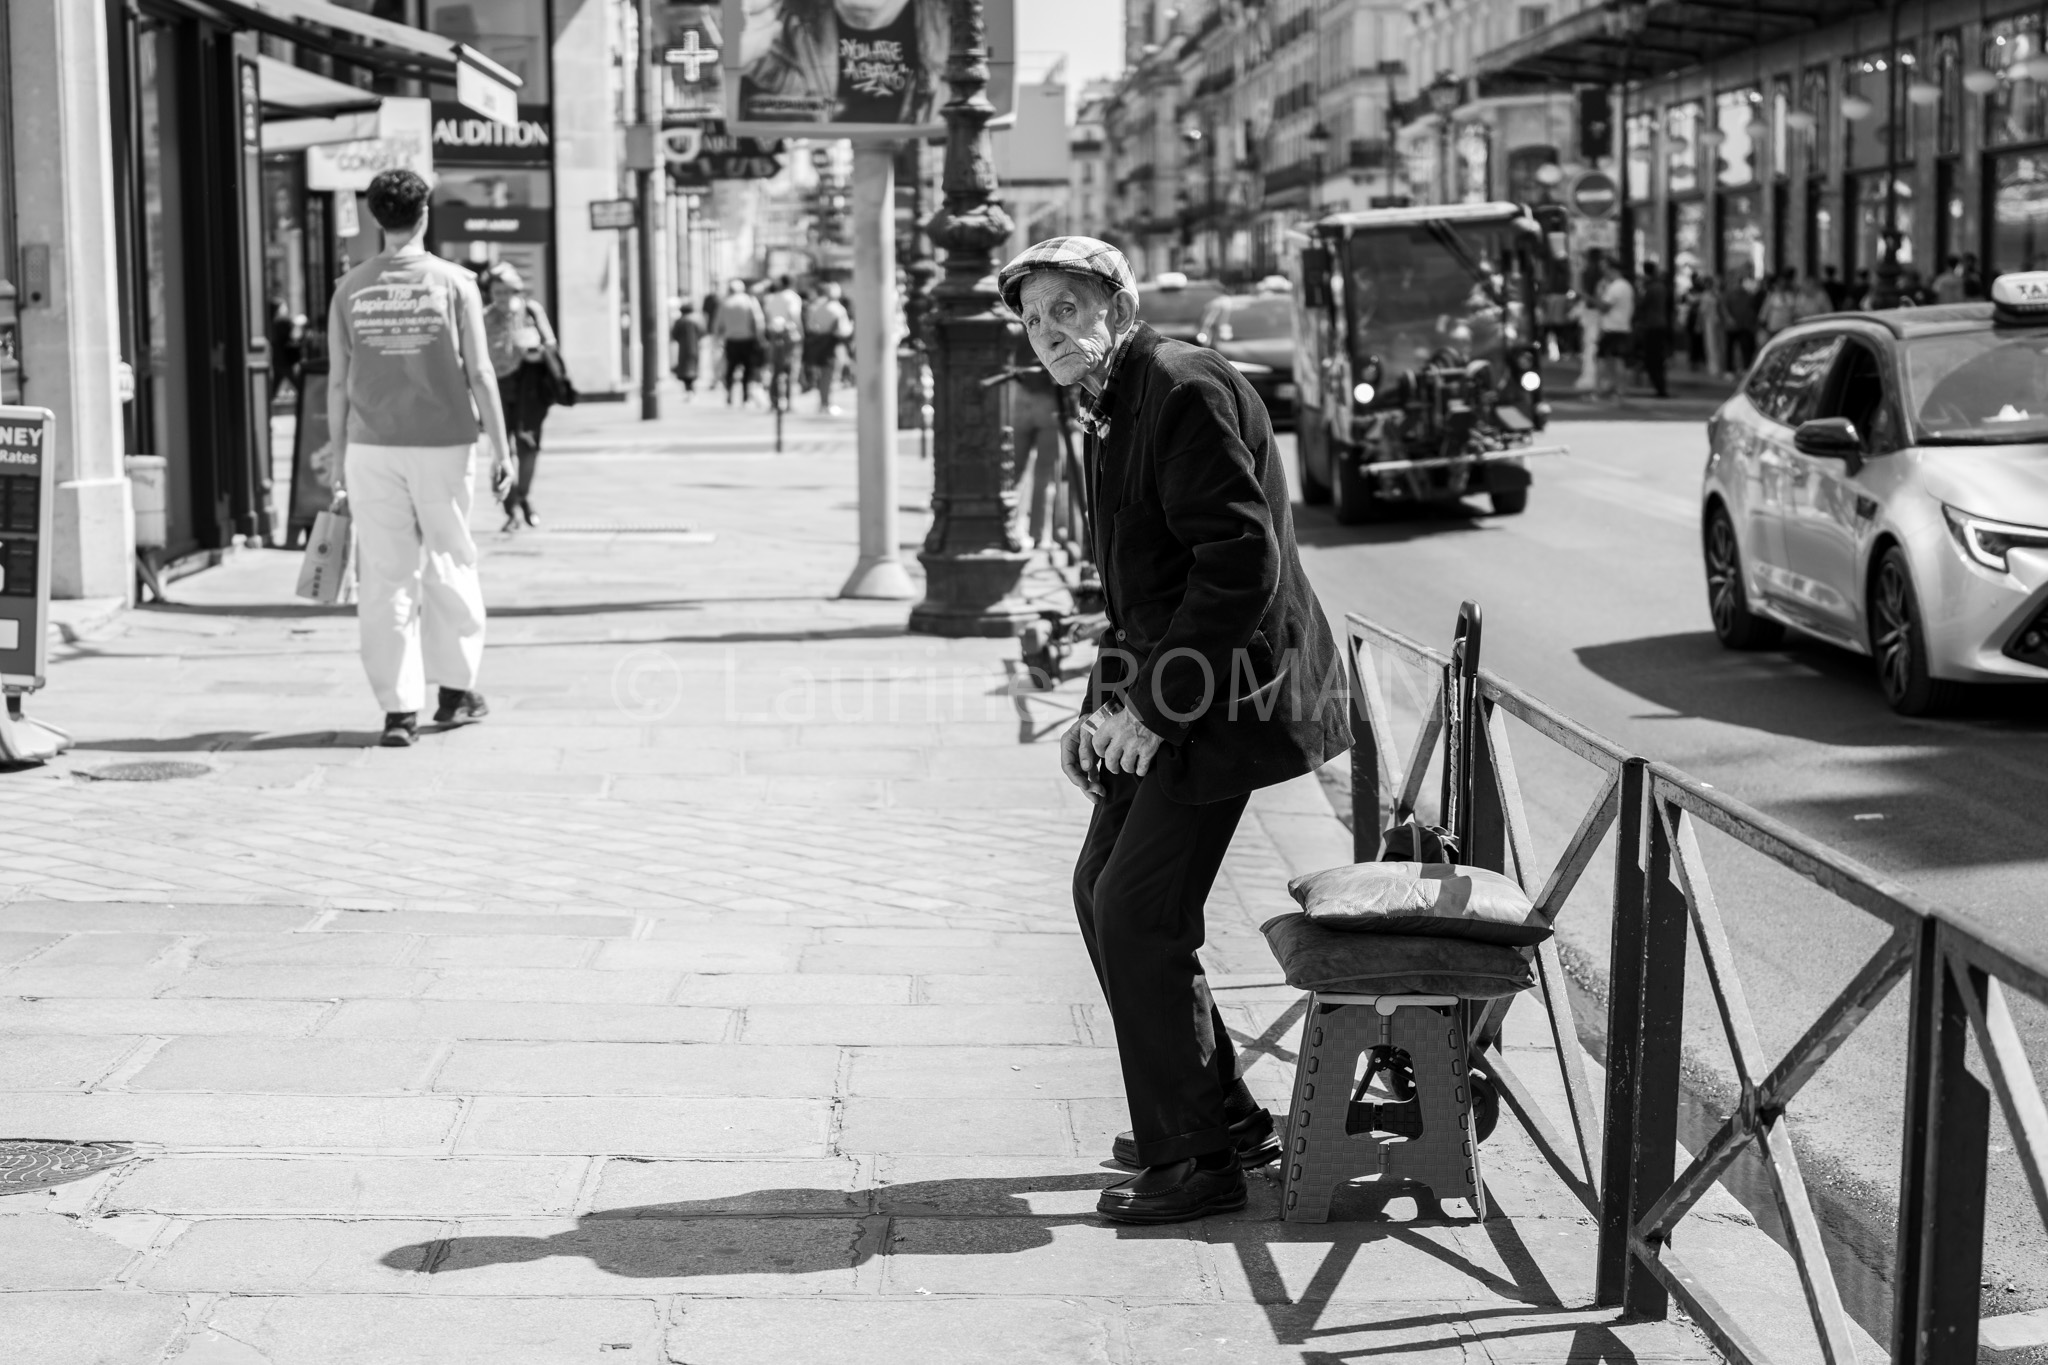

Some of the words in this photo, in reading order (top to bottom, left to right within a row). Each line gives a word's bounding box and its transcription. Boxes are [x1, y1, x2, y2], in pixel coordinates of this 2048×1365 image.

[434, 119, 549, 146] AUDITION
[2016, 284, 2048, 297] TA
[0, 449, 38, 464] Rates
